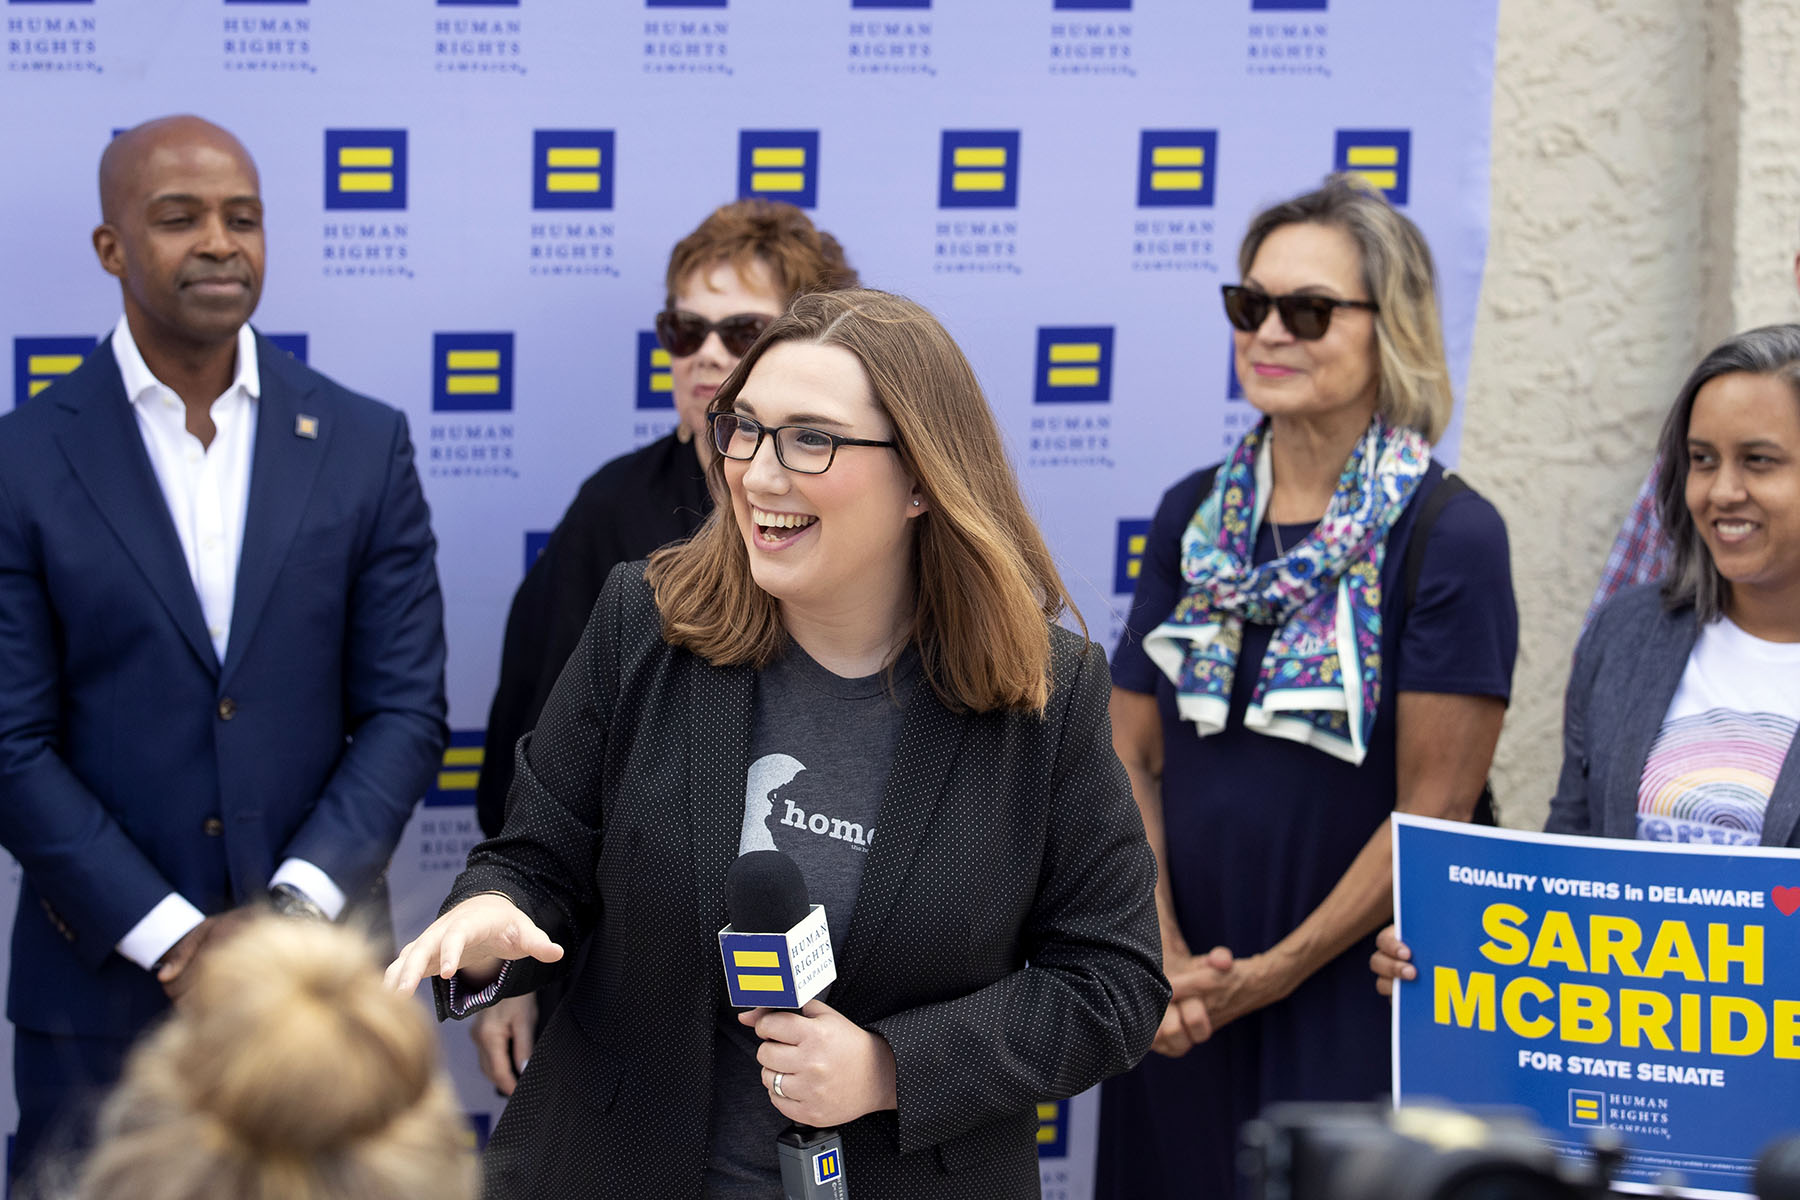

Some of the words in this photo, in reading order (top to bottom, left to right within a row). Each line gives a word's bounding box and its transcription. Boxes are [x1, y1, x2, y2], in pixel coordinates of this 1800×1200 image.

[8, 17, 96, 33] HUMAN
[223, 17, 310, 33] HUMAN
[435, 19, 520, 34] HUMAN
[644, 21, 729, 36] HUMAN
[849, 22, 932, 37] HUMAN
[1051, 23, 1132, 38] HUMAN
[1248, 24, 1328, 38] HUMAN
[8, 39, 96, 54] RIGHTS
[224, 39, 309, 54] RIGHTS
[435, 40, 520, 56] RIGHTS
[644, 42, 728, 57] RIGHTS
[848, 42, 931, 57] RIGHTS
[1050, 43, 1131, 58] RIGHTS
[1247, 44, 1327, 59] RIGHTS
[323, 224, 408, 239] HUMAN
[531, 224, 614, 238] HUMAN
[936, 222, 1017, 236] HUMAN
[1134, 220, 1216, 235] HUMAN
[323, 244, 408, 260] RIGHTS
[530, 244, 614, 259] RIGHTS
[935, 242, 1016, 257] RIGHTS
[1133, 240, 1214, 256] RIGHTS
[1030, 416, 1111, 432] HUMAN
[430, 425, 514, 440] HUMAN
[1029, 435, 1109, 452] RIGHTS
[430, 445, 514, 461] RIGHTS
[1449, 865, 1537, 892] EQUALITY
[1541, 877, 1620, 900] VOTERS
[1625, 884, 1643, 901] in
[1648, 885, 1765, 908] DELAWARE
[791, 922, 827, 959] HUMAN
[1479, 903, 1764, 985] SARAH
[794, 940, 831, 976] RIGHTS
[797, 956, 834, 990] CAMPAIGN
[1434, 966, 1800, 1060] MCBRIDE
[1518, 1050, 1562, 1072] FOR
[1567, 1056, 1632, 1079] STATE
[1636, 1063, 1725, 1087] SENATE
[1609, 1093, 1668, 1109] HUMAN
[1609, 1108, 1669, 1124] RIGHTS
